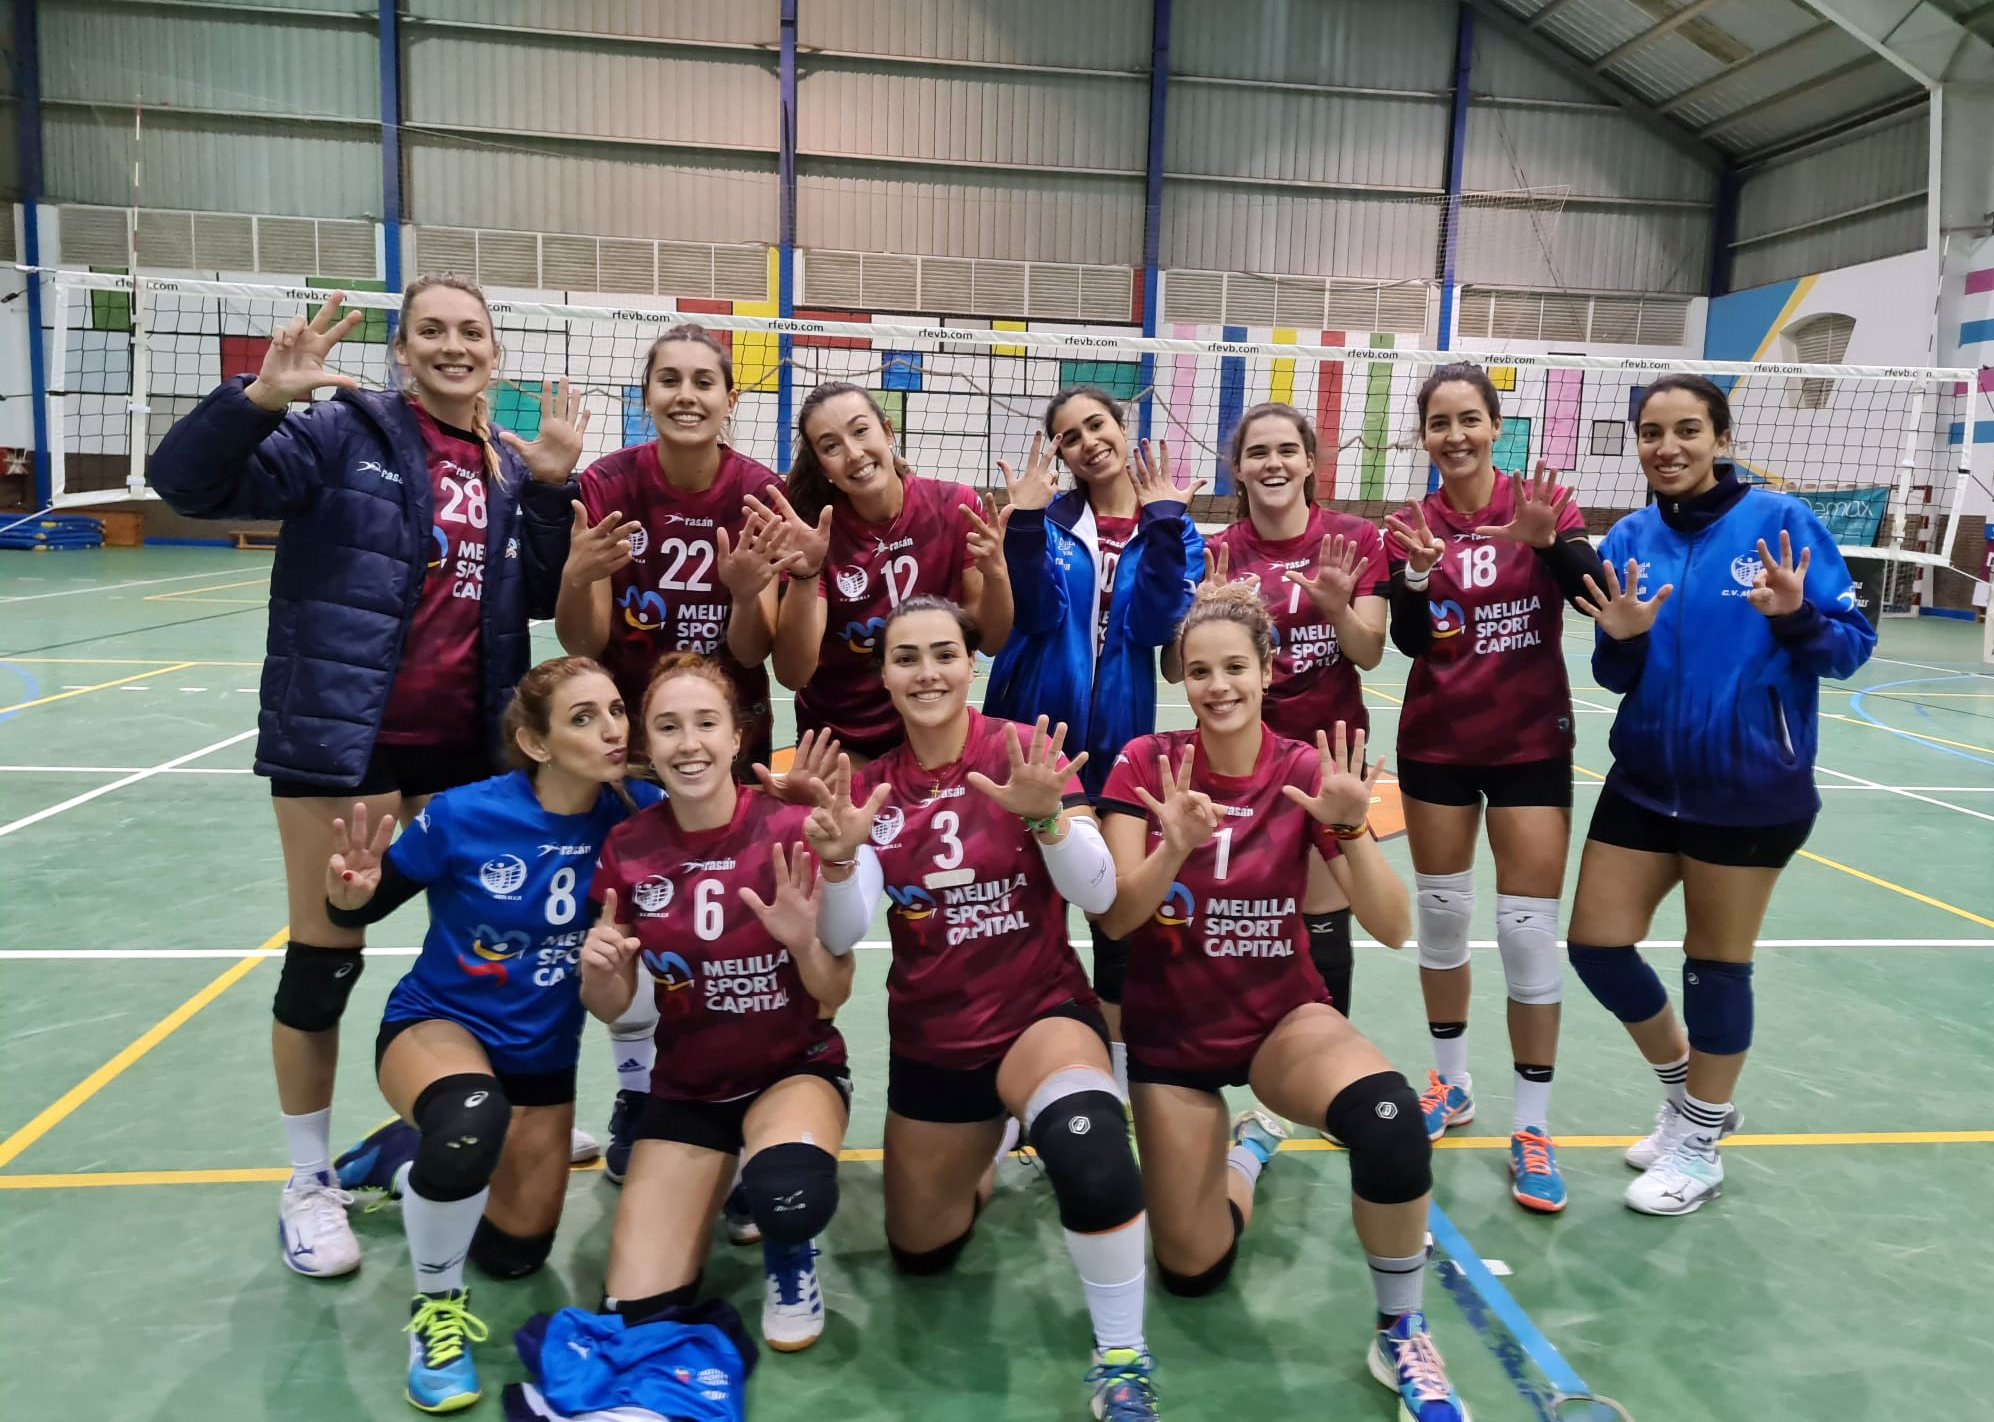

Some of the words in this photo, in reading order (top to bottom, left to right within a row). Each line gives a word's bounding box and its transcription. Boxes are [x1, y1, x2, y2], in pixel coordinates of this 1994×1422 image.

[115, 278, 178, 292] rfe.com
[286, 290, 347, 303] rfevb.c
[612, 311, 670, 323] rfevb.com
[768, 320, 824, 332] rfevb.com
[918, 329, 973, 340] rfevb.com
[1064, 336, 1118, 347] rfevb.com
[1208, 343, 1259, 354] rfevb.com
[1347, 350, 1398, 359] rfevb.com
[1485, 355, 1535, 365] rfevb.com
[1620, 360, 1670, 369] rfevb.com
[1754, 364, 1802, 374] rfevb.com
[440, 477, 488, 529] 28
[658, 537, 714, 592] 22
[1457, 545, 1497, 589] 18
[881, 555, 918, 608] 12
[1475, 596, 1541, 621] MELILLA
[676, 622, 723, 638] SPO
[1476, 615, 1530, 638] SPORT
[1475, 630, 1541, 655] CAPITAL
[931, 811, 964, 869] 3
[1212, 828, 1233, 880] 1
[545, 867, 576, 925] 8
[944, 873, 1027, 905] MELILLA
[694, 878, 724, 941] 6
[1206, 898, 1296, 917] MELILLA
[1205, 918, 1283, 937] SPORT
[1204, 938, 1295, 957] CAPITAL
[702, 949, 790, 977] MELILLA
[703, 972, 777, 996] SPORT
[705, 988, 790, 1013] CAPITAL
